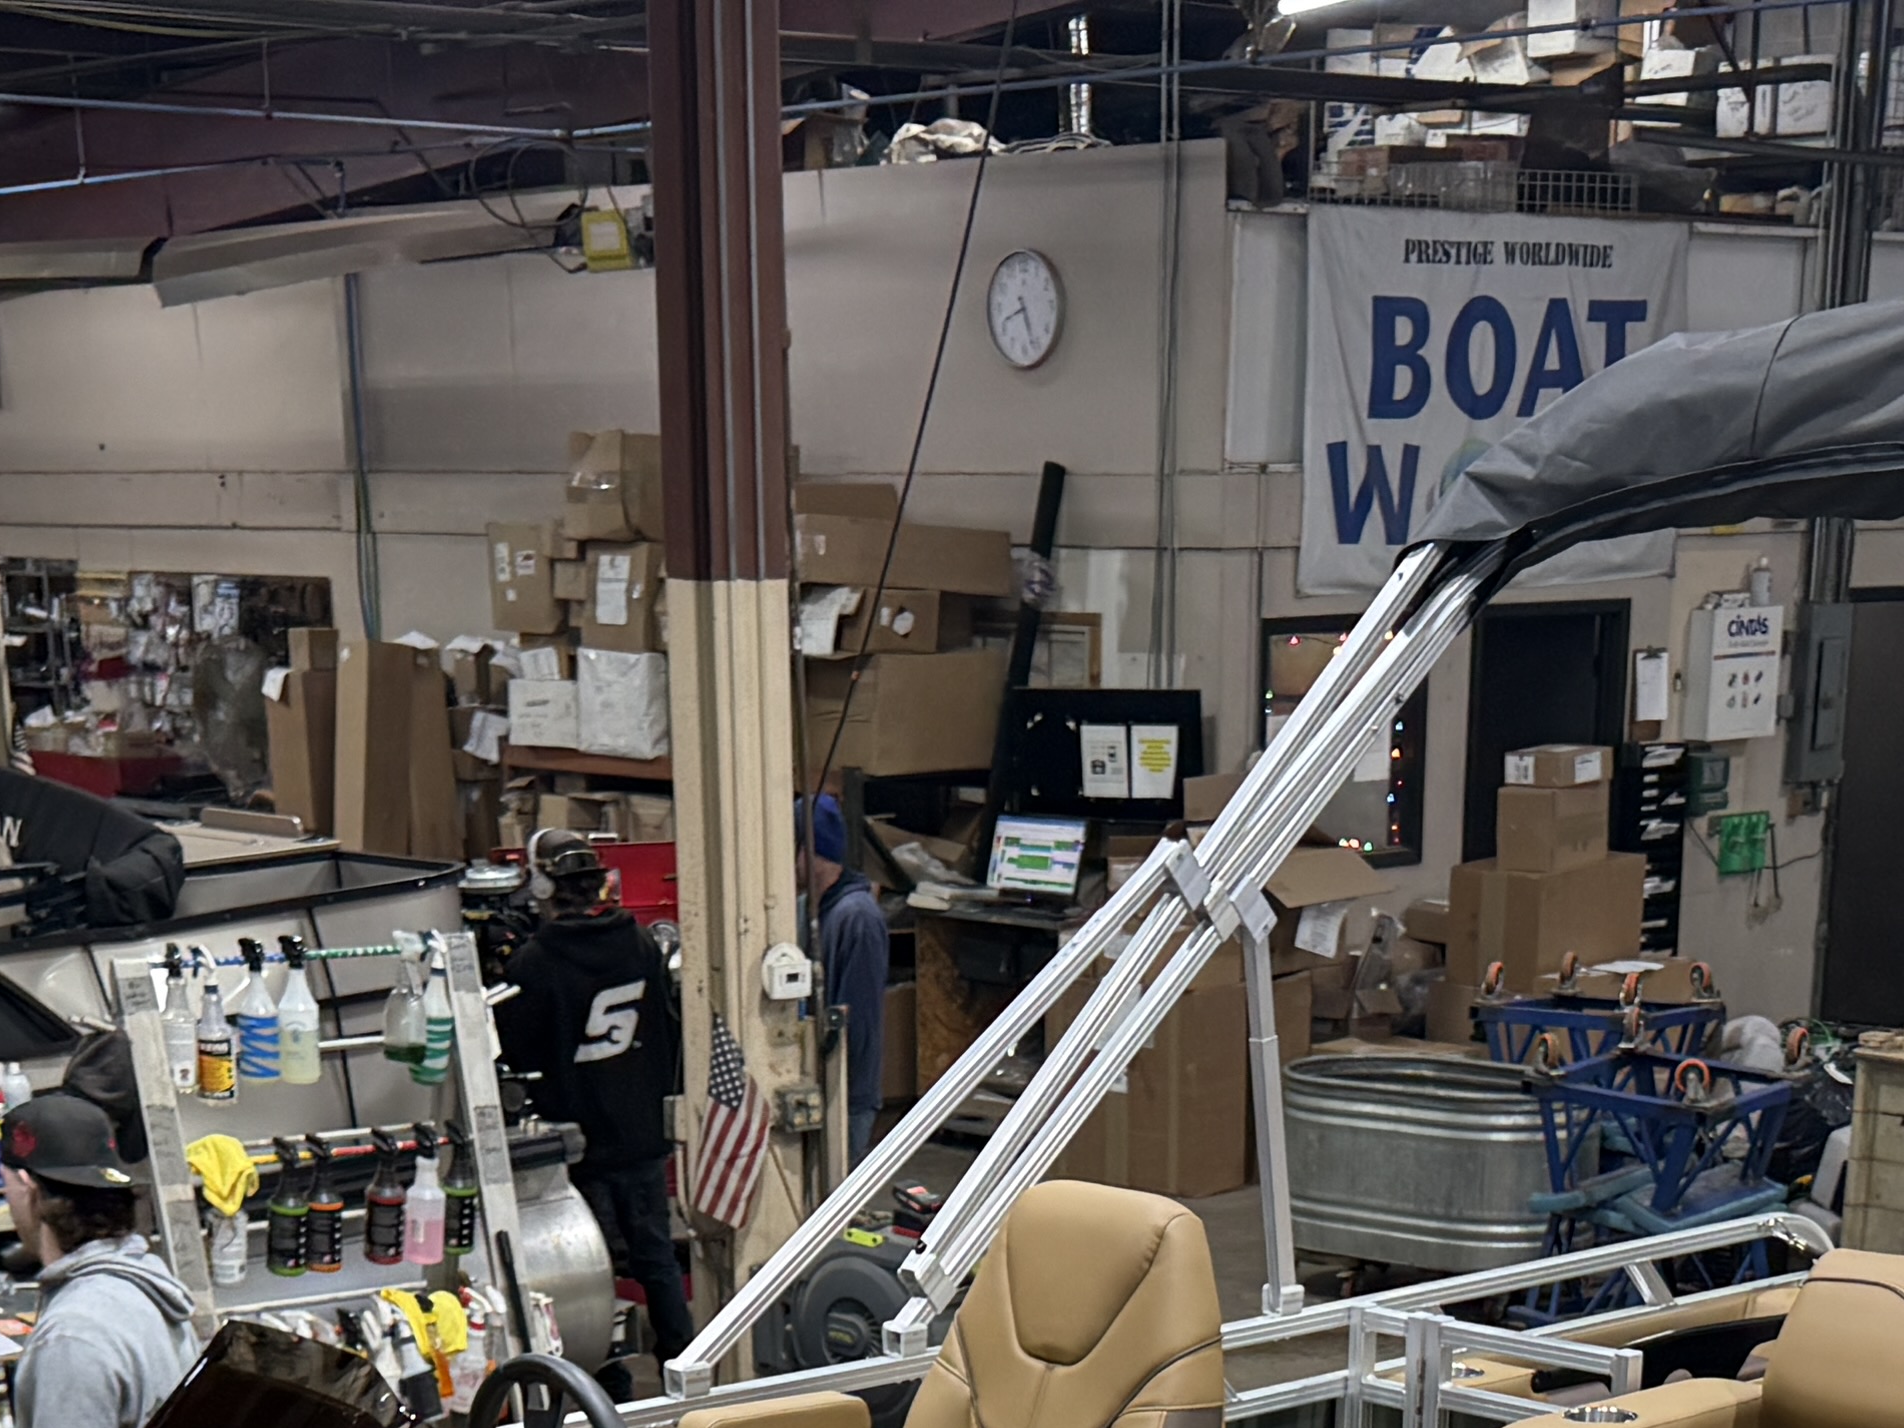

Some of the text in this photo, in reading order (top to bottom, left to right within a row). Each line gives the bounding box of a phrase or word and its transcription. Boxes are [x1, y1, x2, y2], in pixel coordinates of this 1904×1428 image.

[1403, 238, 1614, 269] PRESTIGE WORLDWIDE
[1367, 294, 1648, 421] BOAT
[1727, 614, 1769, 638] CINTAS
